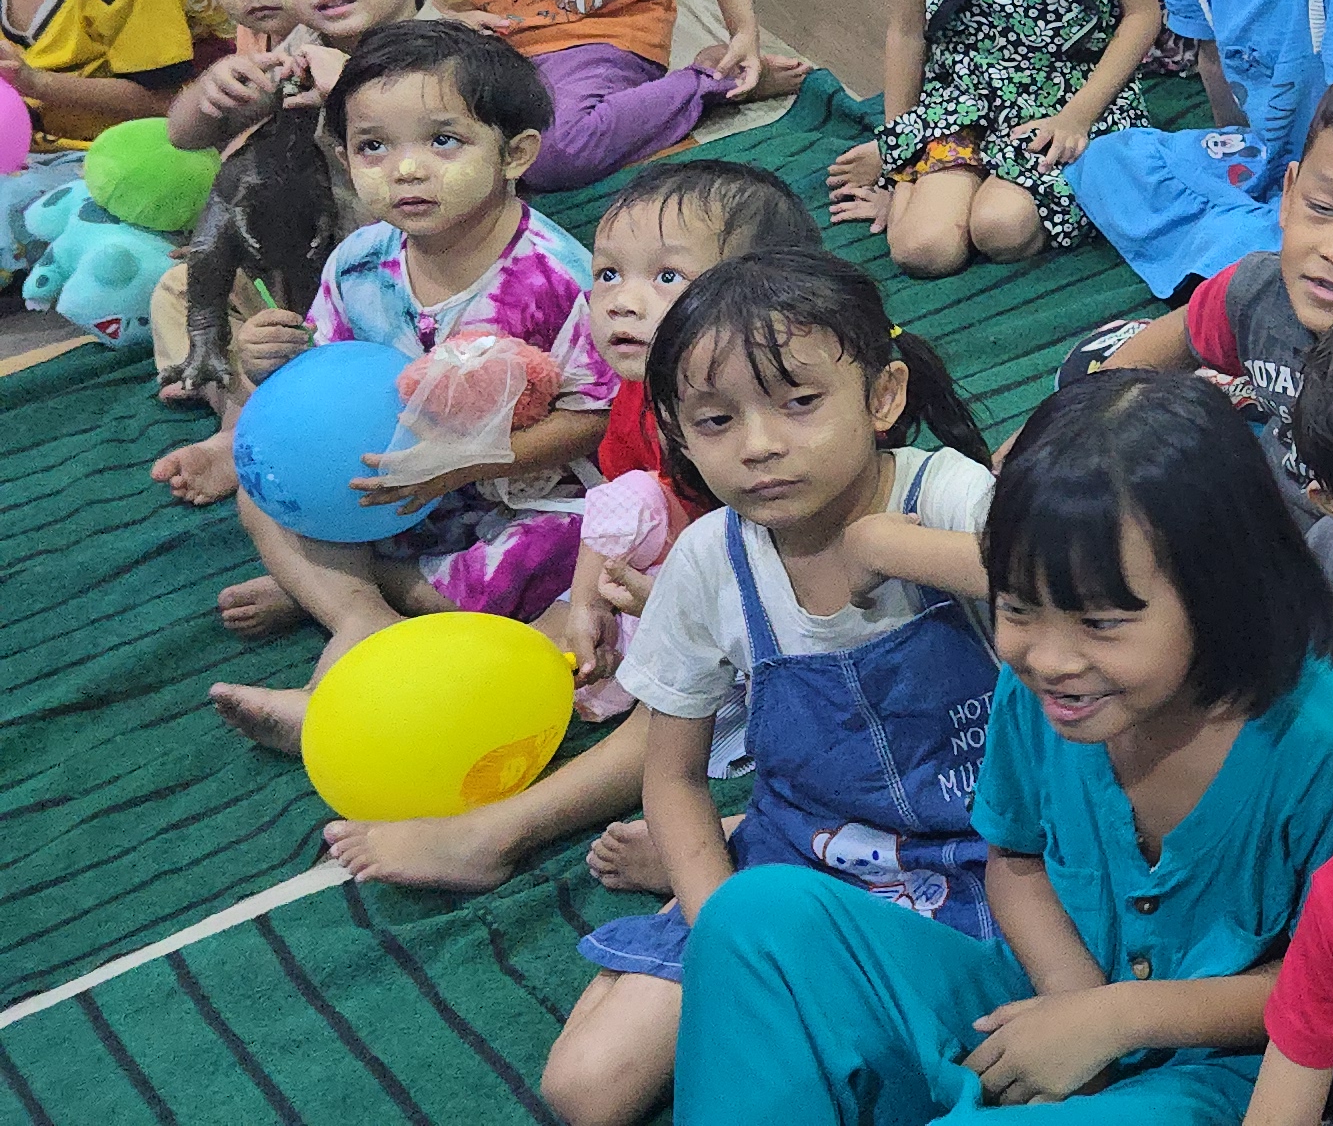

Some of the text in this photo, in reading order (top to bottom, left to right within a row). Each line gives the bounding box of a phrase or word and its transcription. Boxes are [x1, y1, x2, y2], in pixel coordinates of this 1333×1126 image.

[948, 691, 994, 729] HOT
[951, 723, 989, 756] NO
[937, 758, 984, 802] MU
